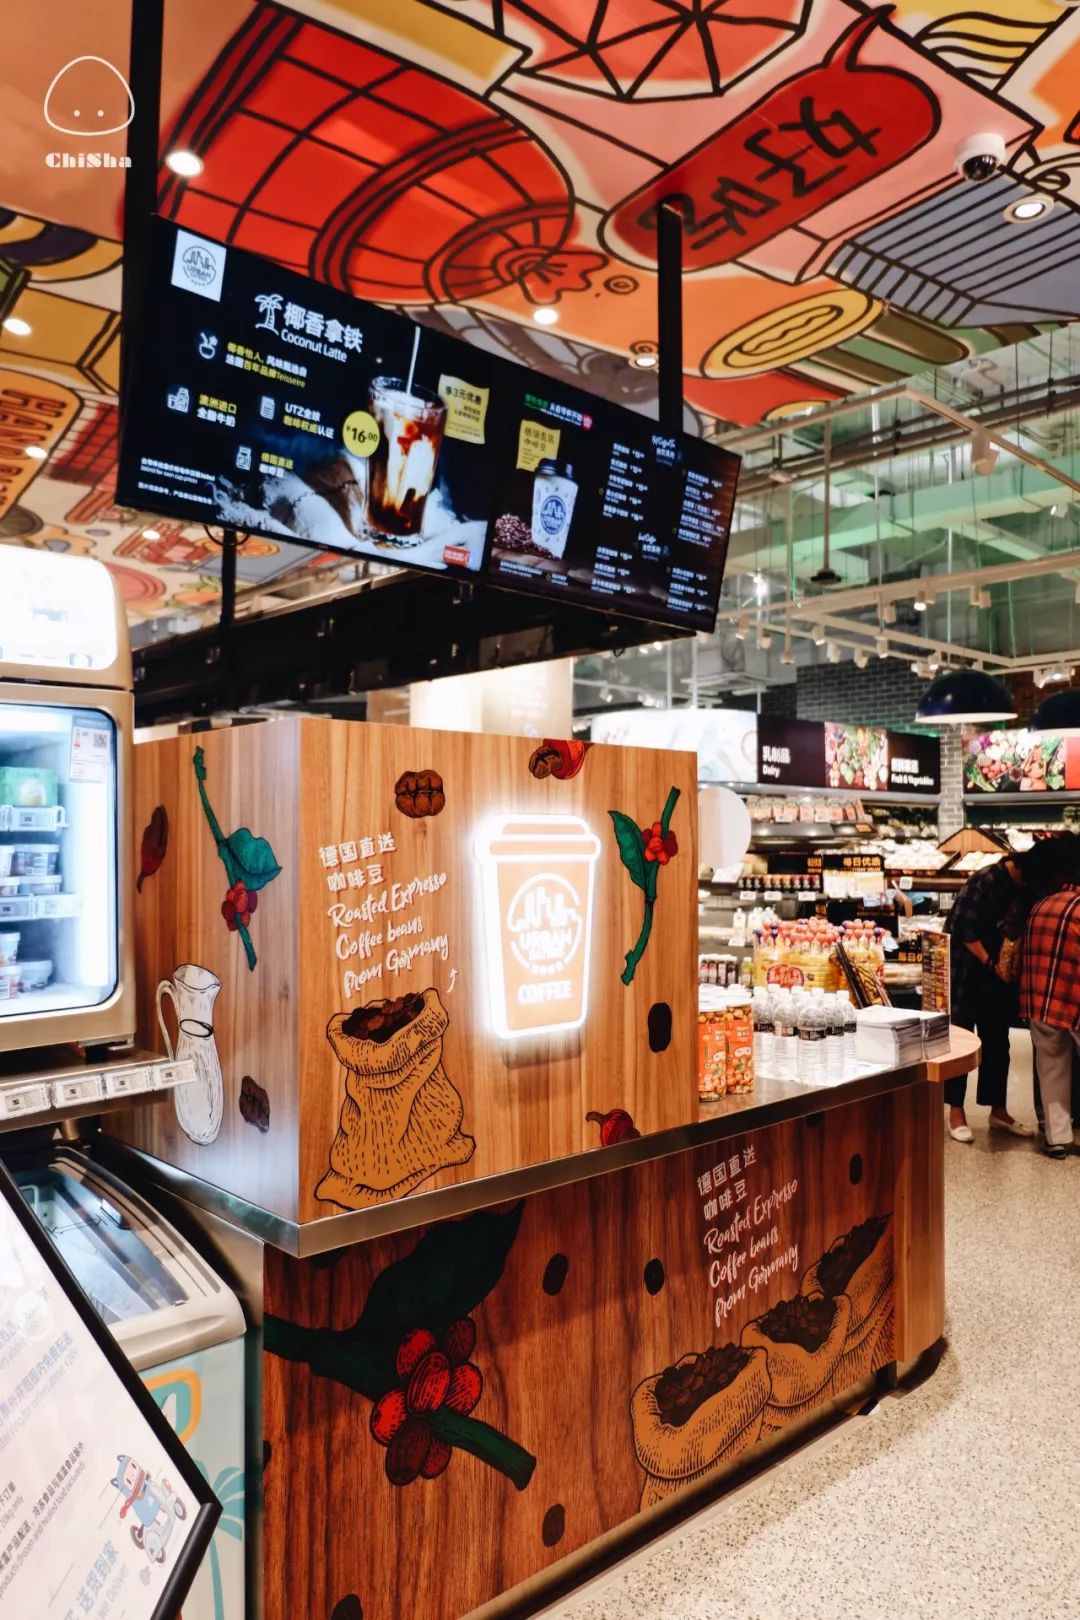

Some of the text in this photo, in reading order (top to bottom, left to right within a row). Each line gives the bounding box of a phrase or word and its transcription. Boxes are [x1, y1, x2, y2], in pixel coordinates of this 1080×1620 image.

[281, 328, 348, 364] Coconut Latte
[283, 302, 363, 353] 椰香拿铁
[284, 402, 321, 422] UTZ全球
[762, 764, 781, 778] Dairy
[319, 832, 397, 868] 德国直送
[327, 864, 385, 892] 咖啡豆
[327, 872, 447, 928] Roasted Expresso
[335, 916, 423, 960] Coffee beans
[520, 928, 572, 950] URBAN
[344, 934, 449, 998] from Germany
[518, 980, 573, 1004] COFFEE
[697, 1144, 757, 1196] 德国直送
[703, 1178, 748, 1221] 咖啡豆
[704, 1179, 798, 1253] Roasted Expresso
[709, 1225, 779, 1288] Coffee beans
[715, 1243, 799, 1328] from Germany
[76, 1539, 119, 1615] 送货到家
